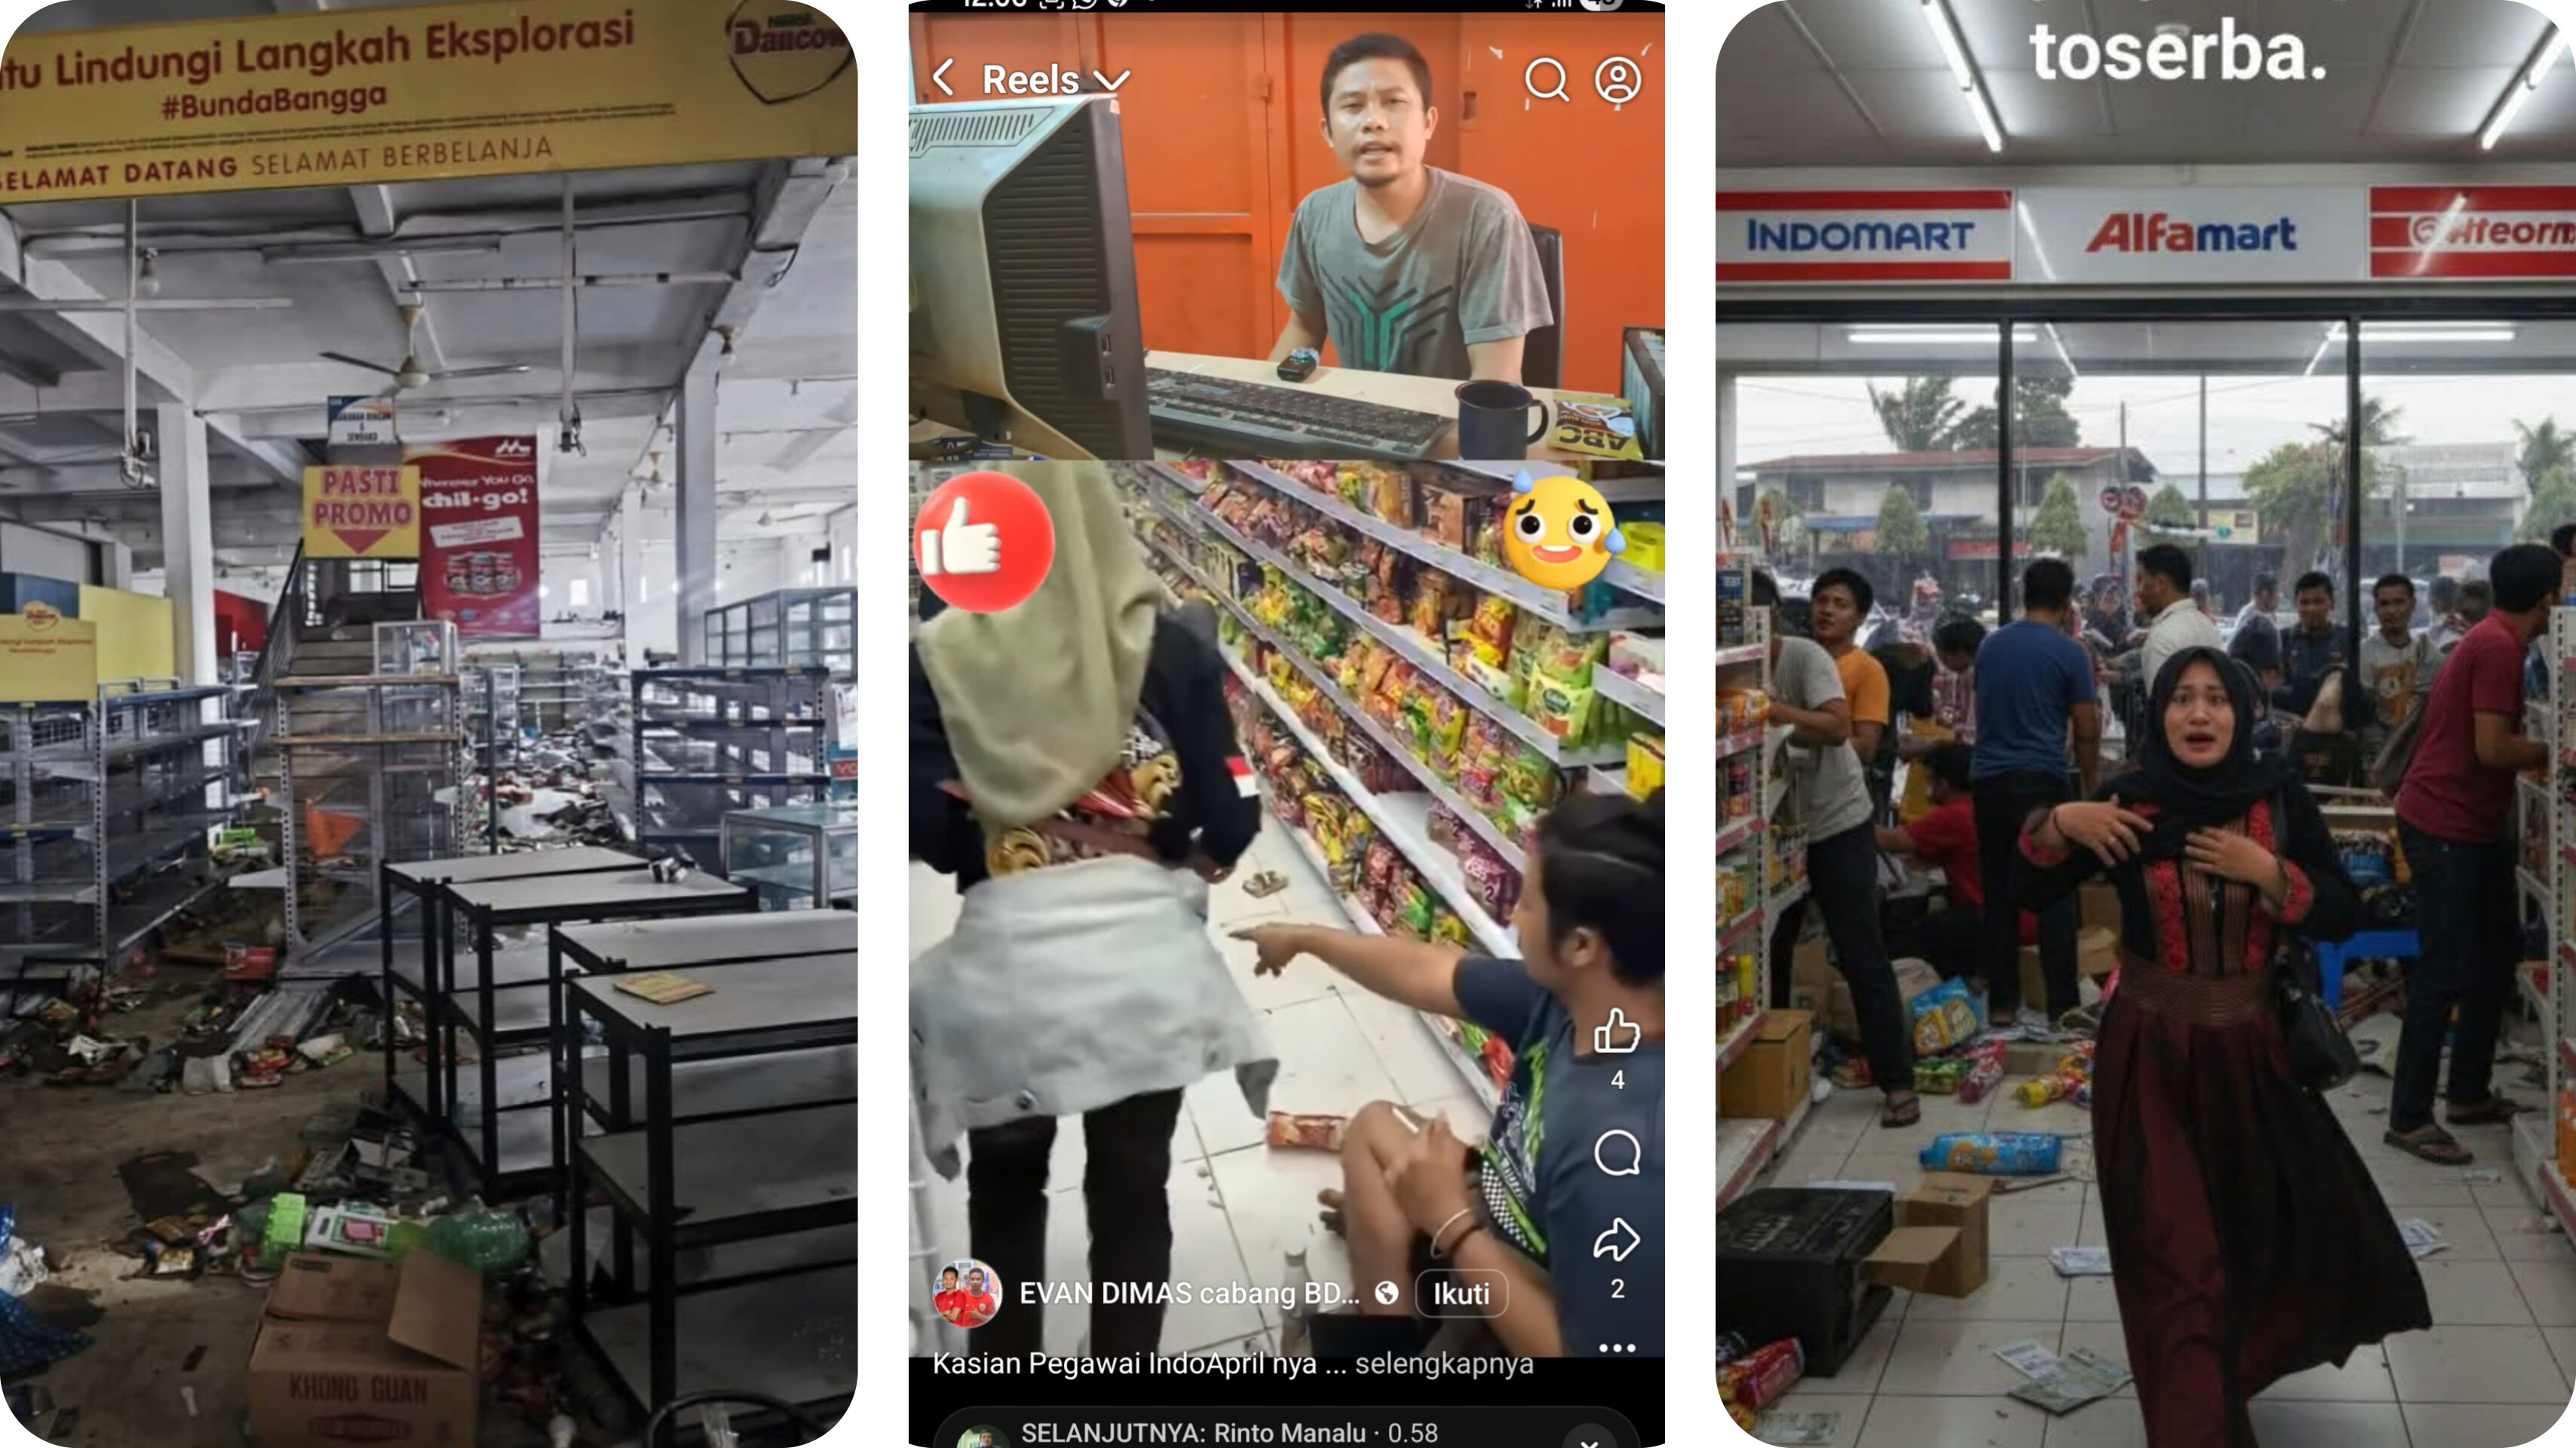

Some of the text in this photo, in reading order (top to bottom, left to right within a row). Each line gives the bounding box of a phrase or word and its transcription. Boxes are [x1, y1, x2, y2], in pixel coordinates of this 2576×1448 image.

[0, 10, 635, 90] tu Lindungi Langkah Eksplorasi
[161, 84, 388, 121] #BundaBangga
[124, 156, 238, 183] DATANG
[252, 149, 369, 176] SELAMAT
[382, 136, 553, 167] BERBELANJA
[2085, 213, 2298, 253] Alfamart
[1559, 425, 1630, 451] ABC
[323, 469, 400, 494] PASTI
[481, 474, 510, 486] You
[314, 502, 412, 526] PROMO
[290, 1372, 428, 1404] KHONG GUAN
